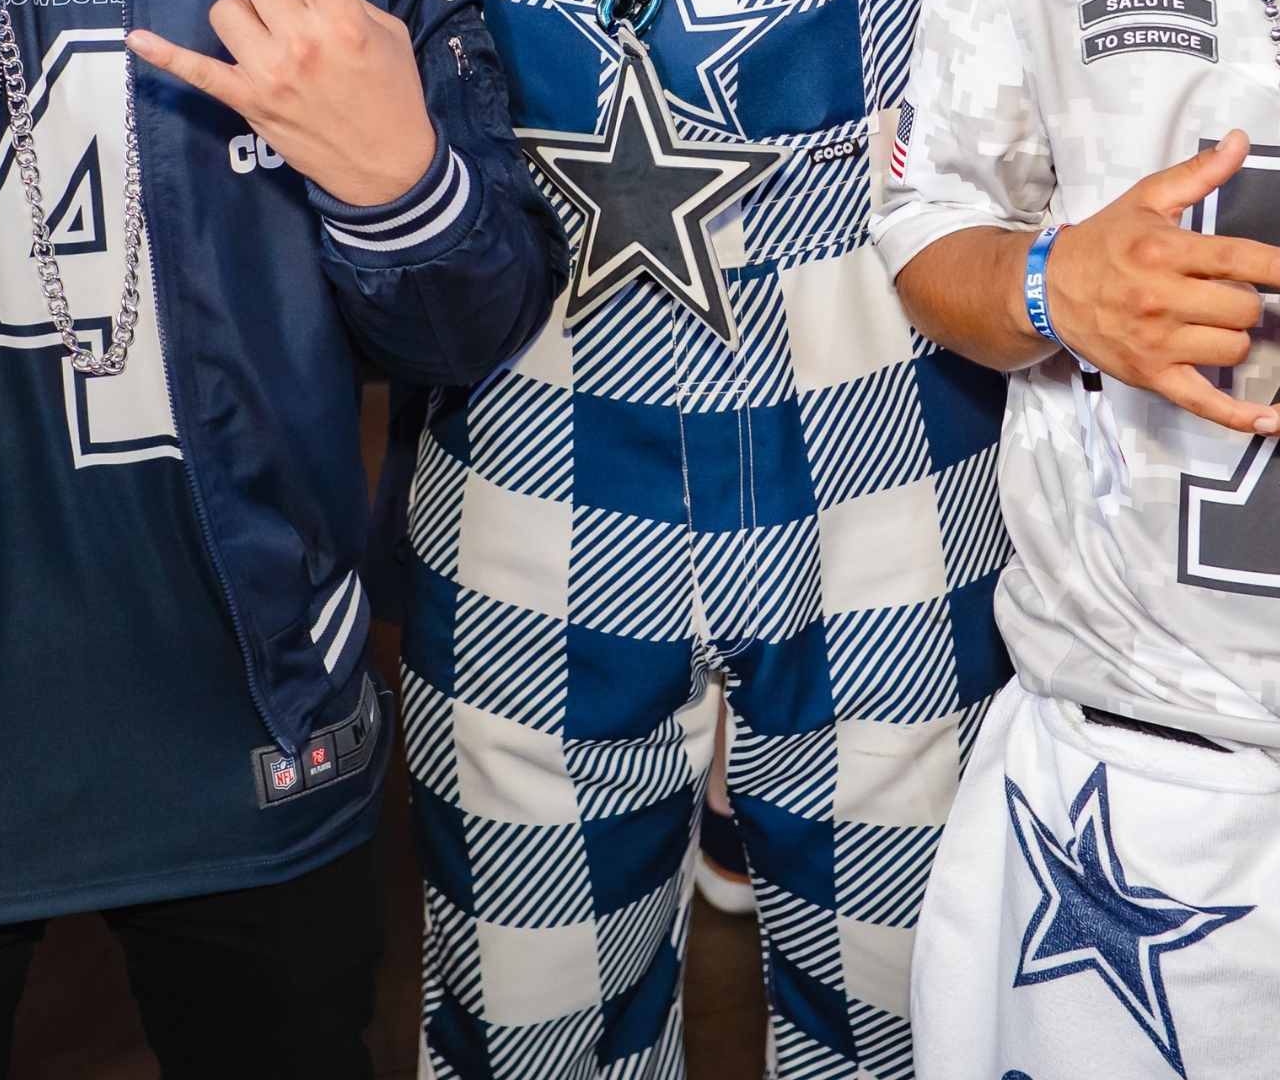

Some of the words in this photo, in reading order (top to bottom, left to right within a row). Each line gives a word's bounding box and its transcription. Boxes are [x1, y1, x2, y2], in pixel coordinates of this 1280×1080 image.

[1094, 35, 1118, 51] TO
[1123, 30, 1202, 50] SERVICE
[813, 141, 854, 163] FOCO
[1027, 272, 1056, 340] ALLAS
[275, 769, 294, 786] NFL
